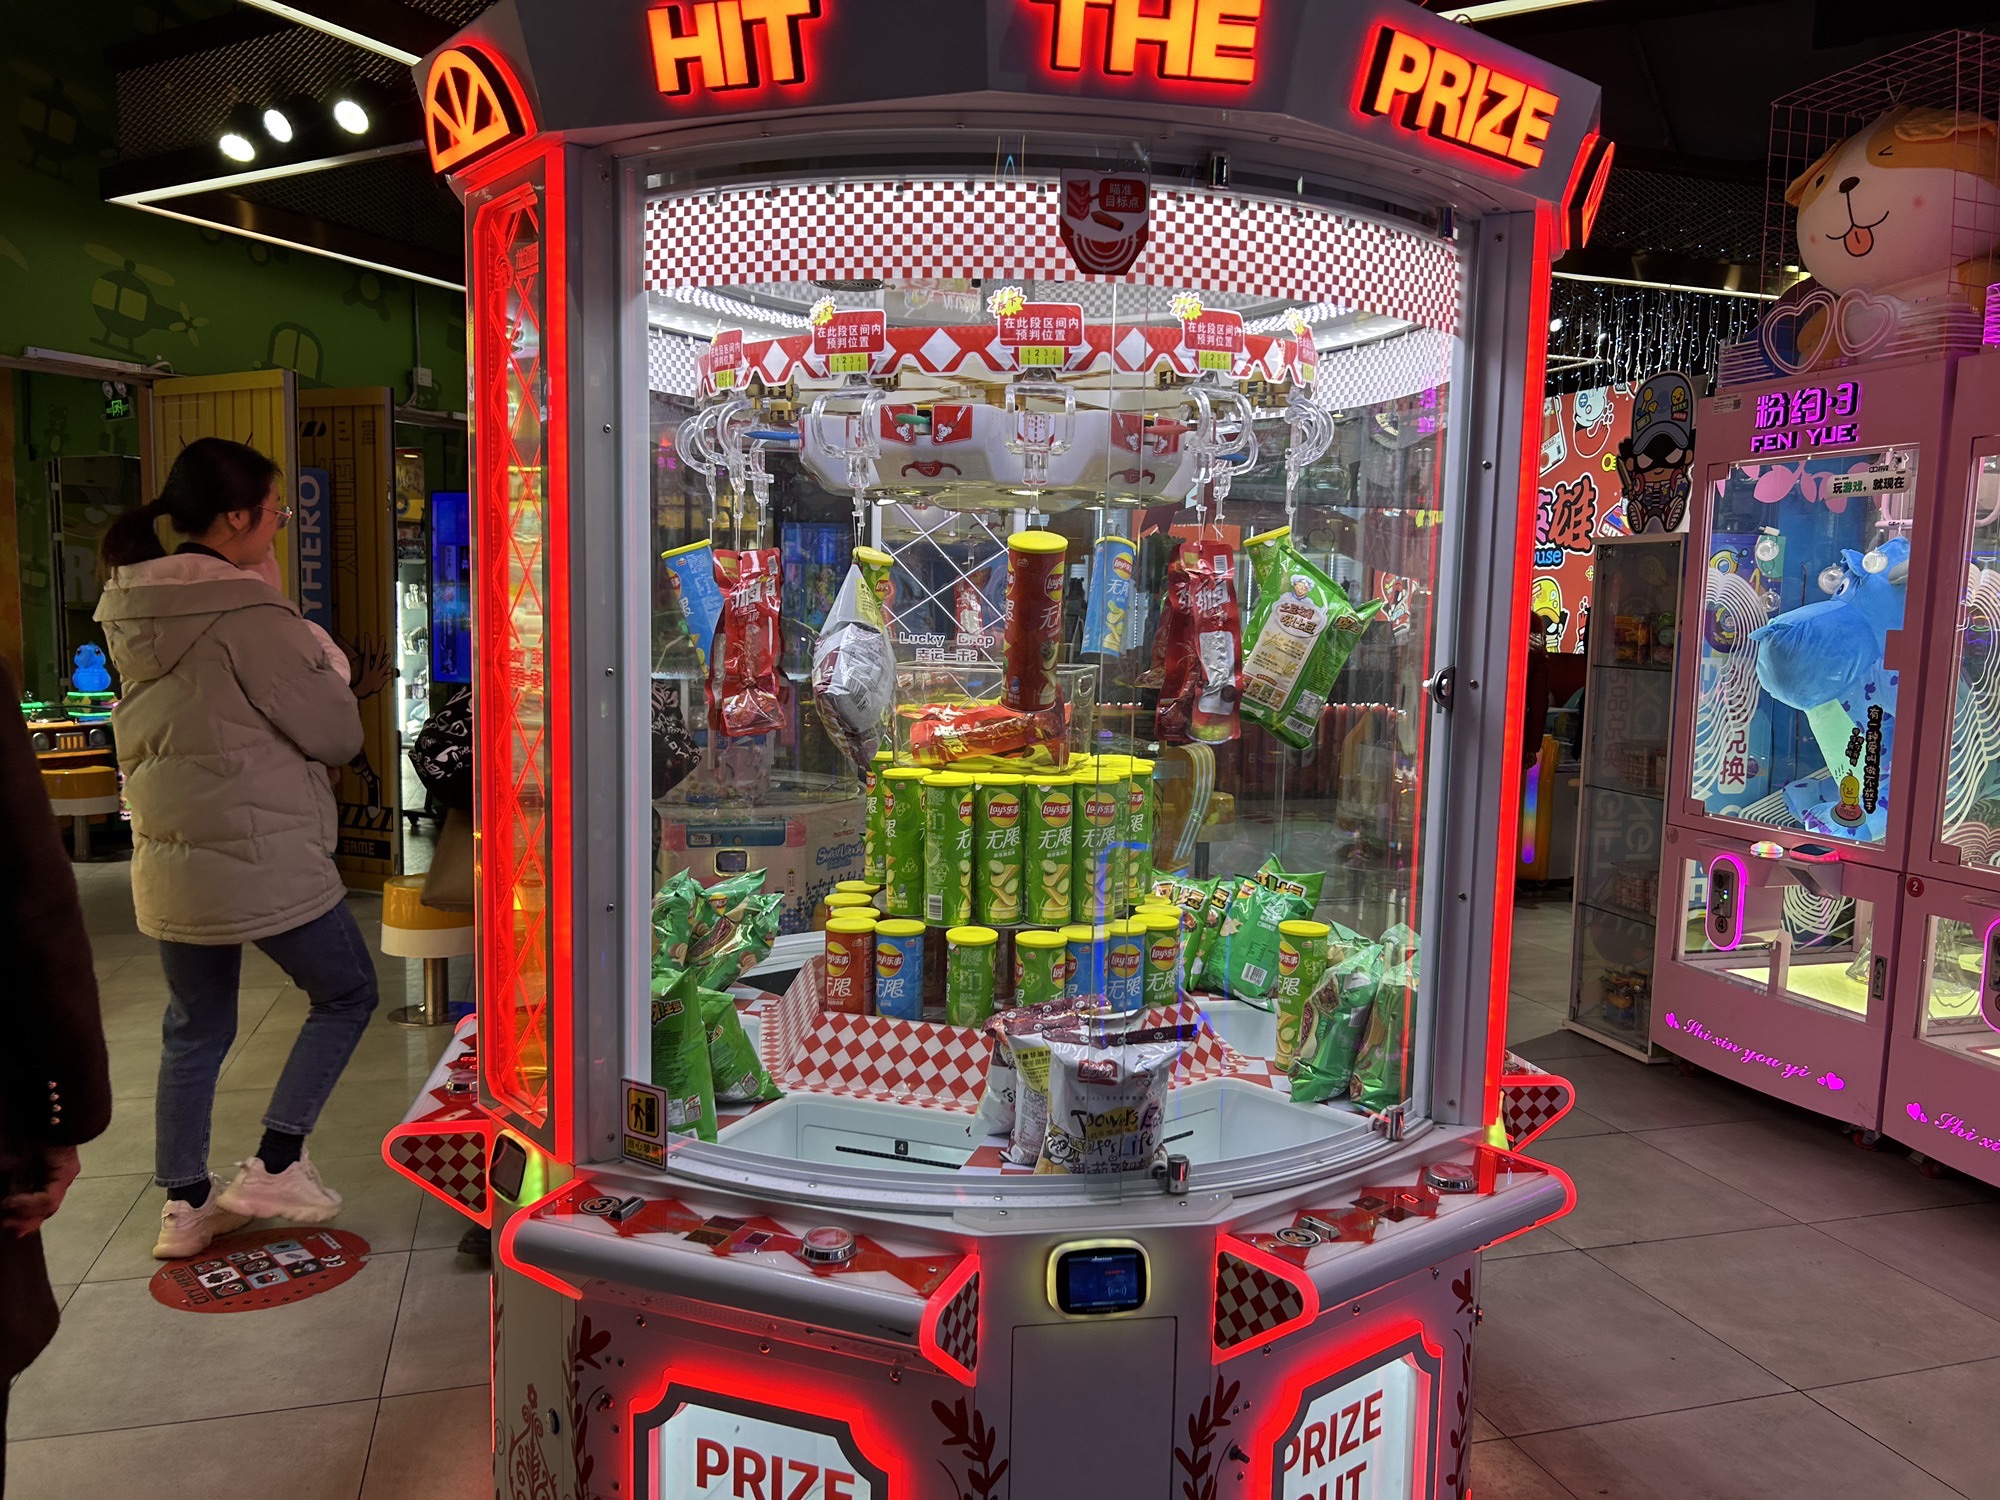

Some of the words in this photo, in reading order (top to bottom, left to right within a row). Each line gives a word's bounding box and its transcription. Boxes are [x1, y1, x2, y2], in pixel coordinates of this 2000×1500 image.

[648, 0, 812, 93] HIT
[1052, 0, 1262, 82] THE
[1372, 28, 1561, 169] PRIZE
[1109, 183, 1133, 195] 瞄准
[1105, 195, 1139, 208] 目标点
[816, 323, 882, 338] 在此段区间内
[1003, 317, 1079, 330] 在此段区间内
[1186, 321, 1242, 337] 在此段区间内
[826, 336, 870, 349] 预判位置
[1015, 329, 1066, 341] 预判位置
[1196, 334, 1233, 348] 预判位置
[1751, 431, 1793, 452] FEN
[1805, 424, 1853, 445] YUE
[899, 632, 946, 647] Lucky
[956, 633, 995, 648] Drop
[985, 825, 1021, 851] 无限
[1038, 825, 1072, 850] 无限
[1081, 825, 1116, 848] 无限
[344, 841, 375, 856] GAME
[1912, 882, 1919, 892] 2
[1717, 919, 1726, 932] 4
[1683, 1018, 1713, 1041] Shi
[1711, 1035, 1743, 1054] xin
[1740, 1048, 1783, 1069] you
[1780, 1062, 1811, 1079] yi
[1934, 1112, 1979, 1142] Shi
[898, 1143, 904, 1151] 4
[596, 1197, 610, 1211] 3
[1284, 1388, 1384, 1478] PRIZE
[696, 1437, 856, 1500] PRIZE
